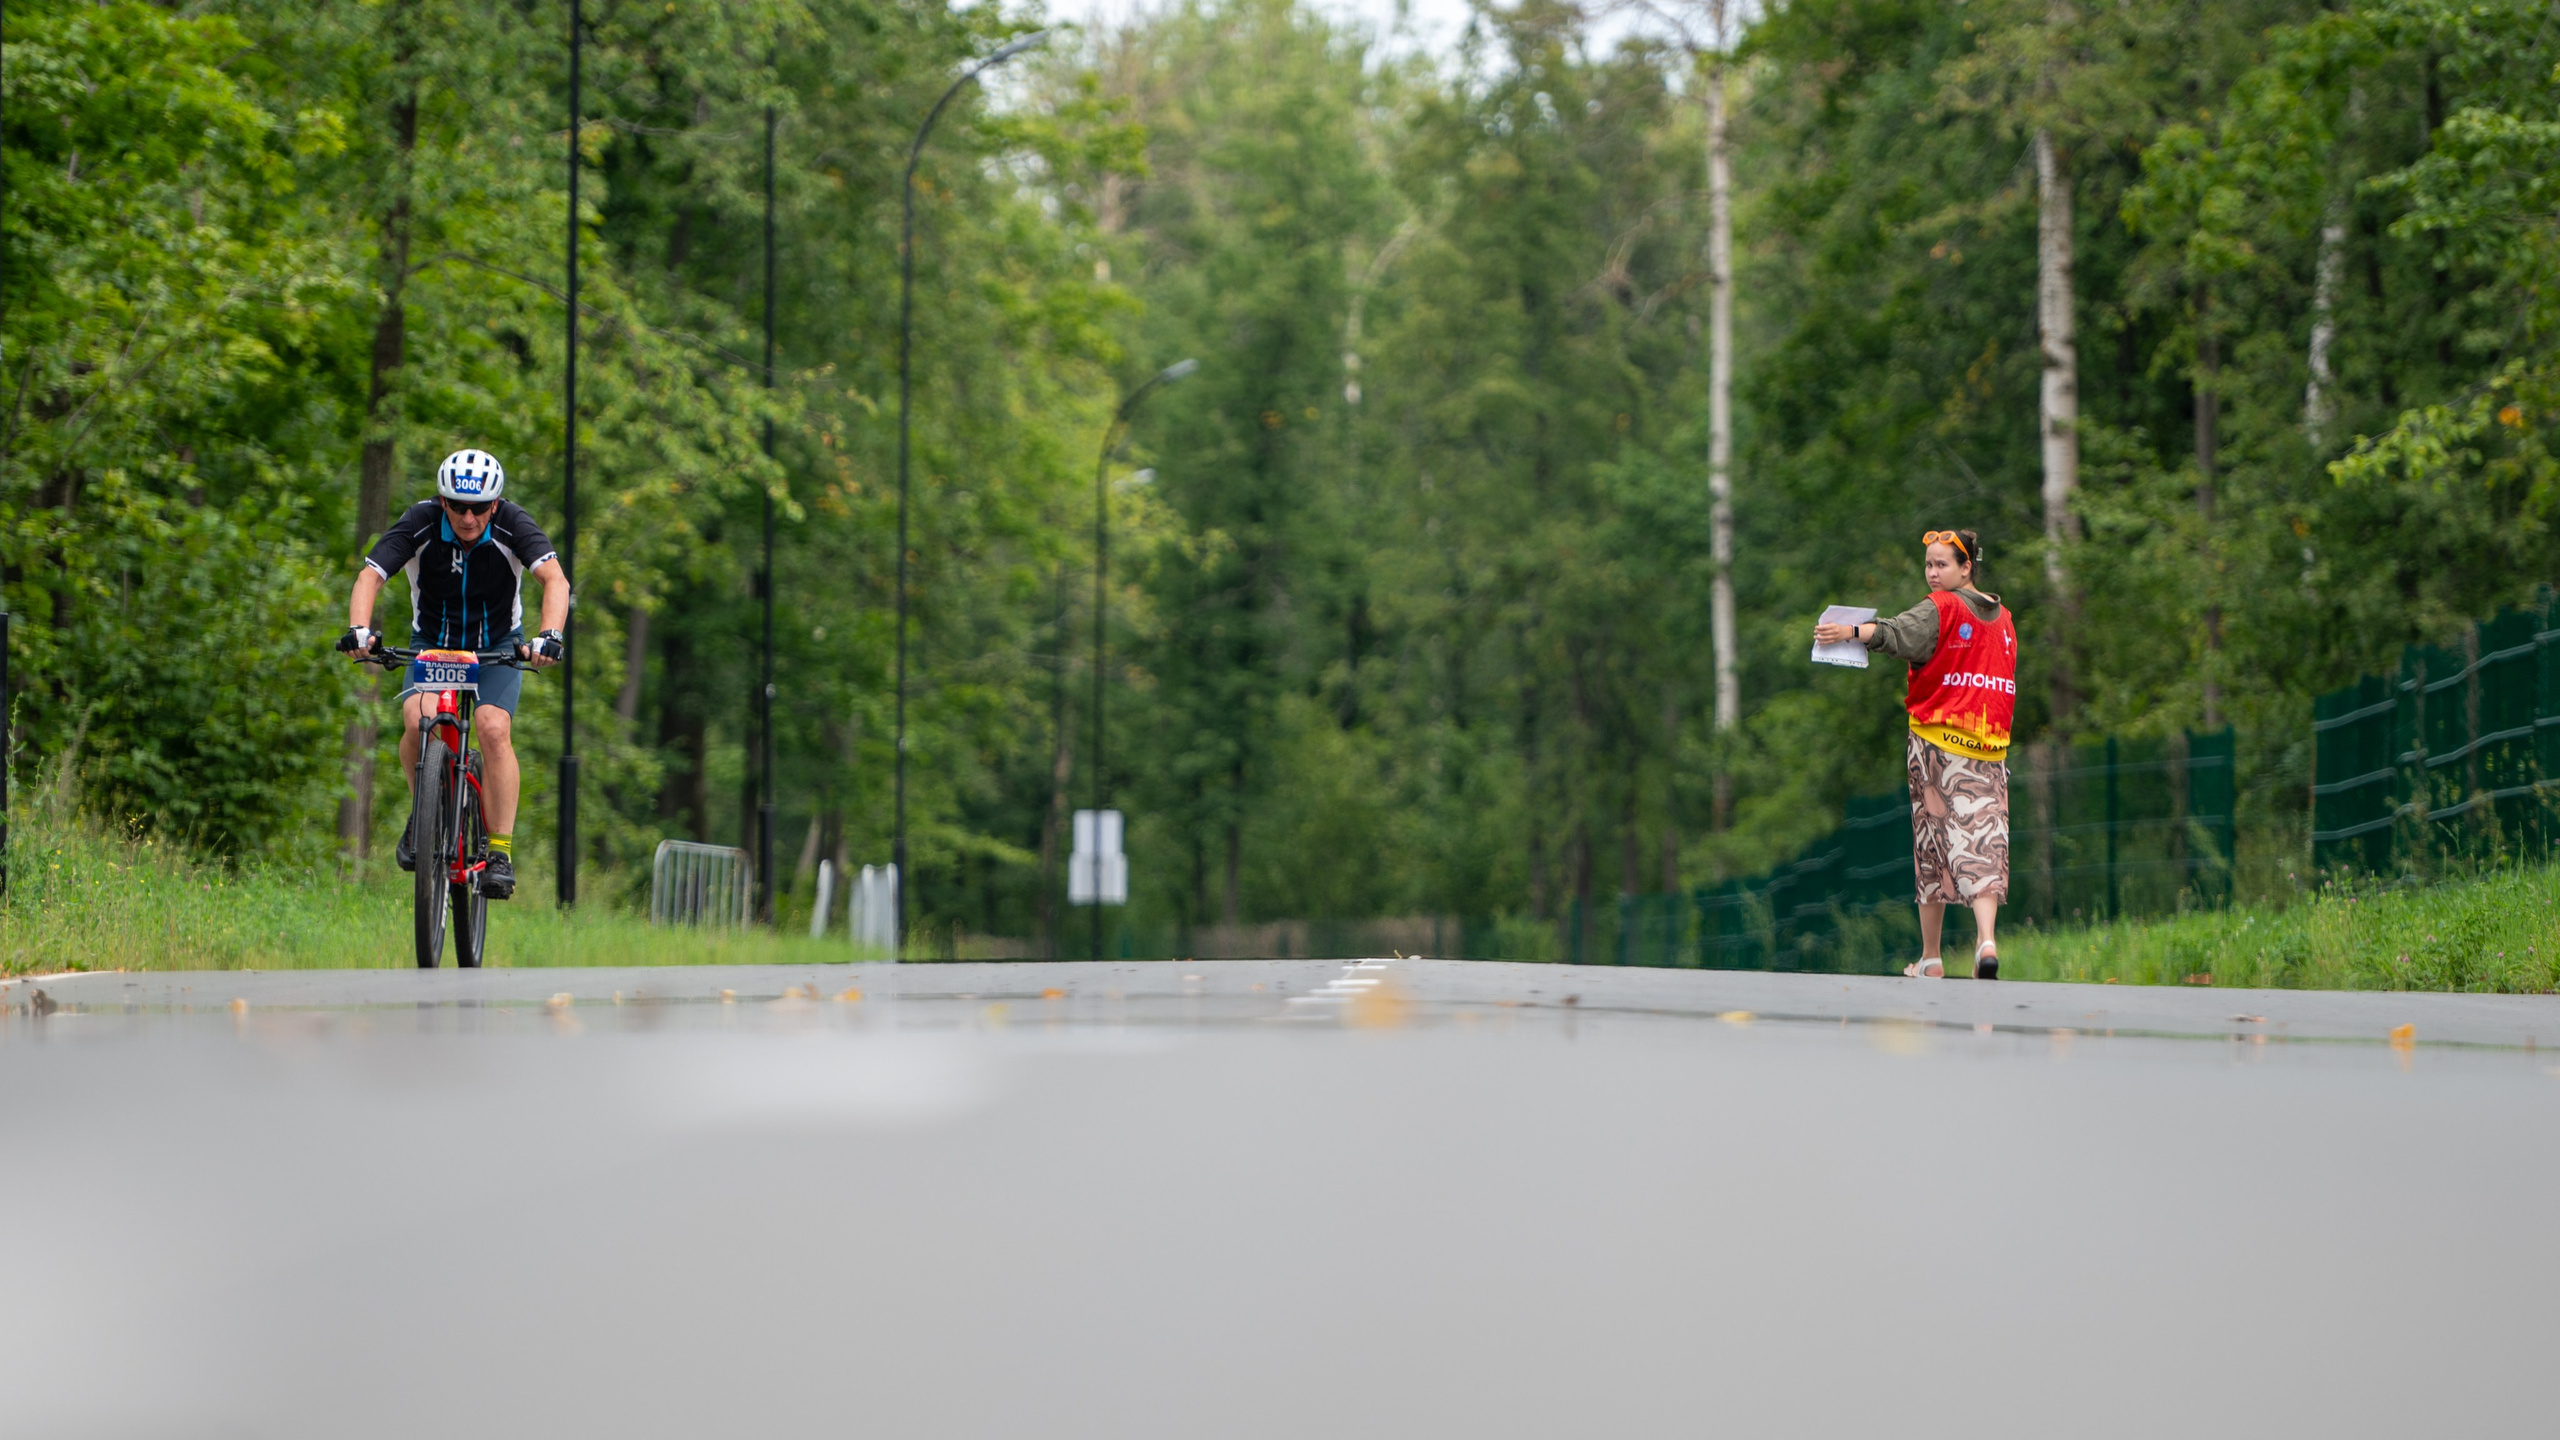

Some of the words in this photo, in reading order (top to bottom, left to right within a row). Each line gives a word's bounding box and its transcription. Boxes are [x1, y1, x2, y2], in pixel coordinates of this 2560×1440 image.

[455, 478, 482, 492] 3006
[425, 661, 471, 670] ВЛАДИМИР
[424, 668, 467, 682] 3006
